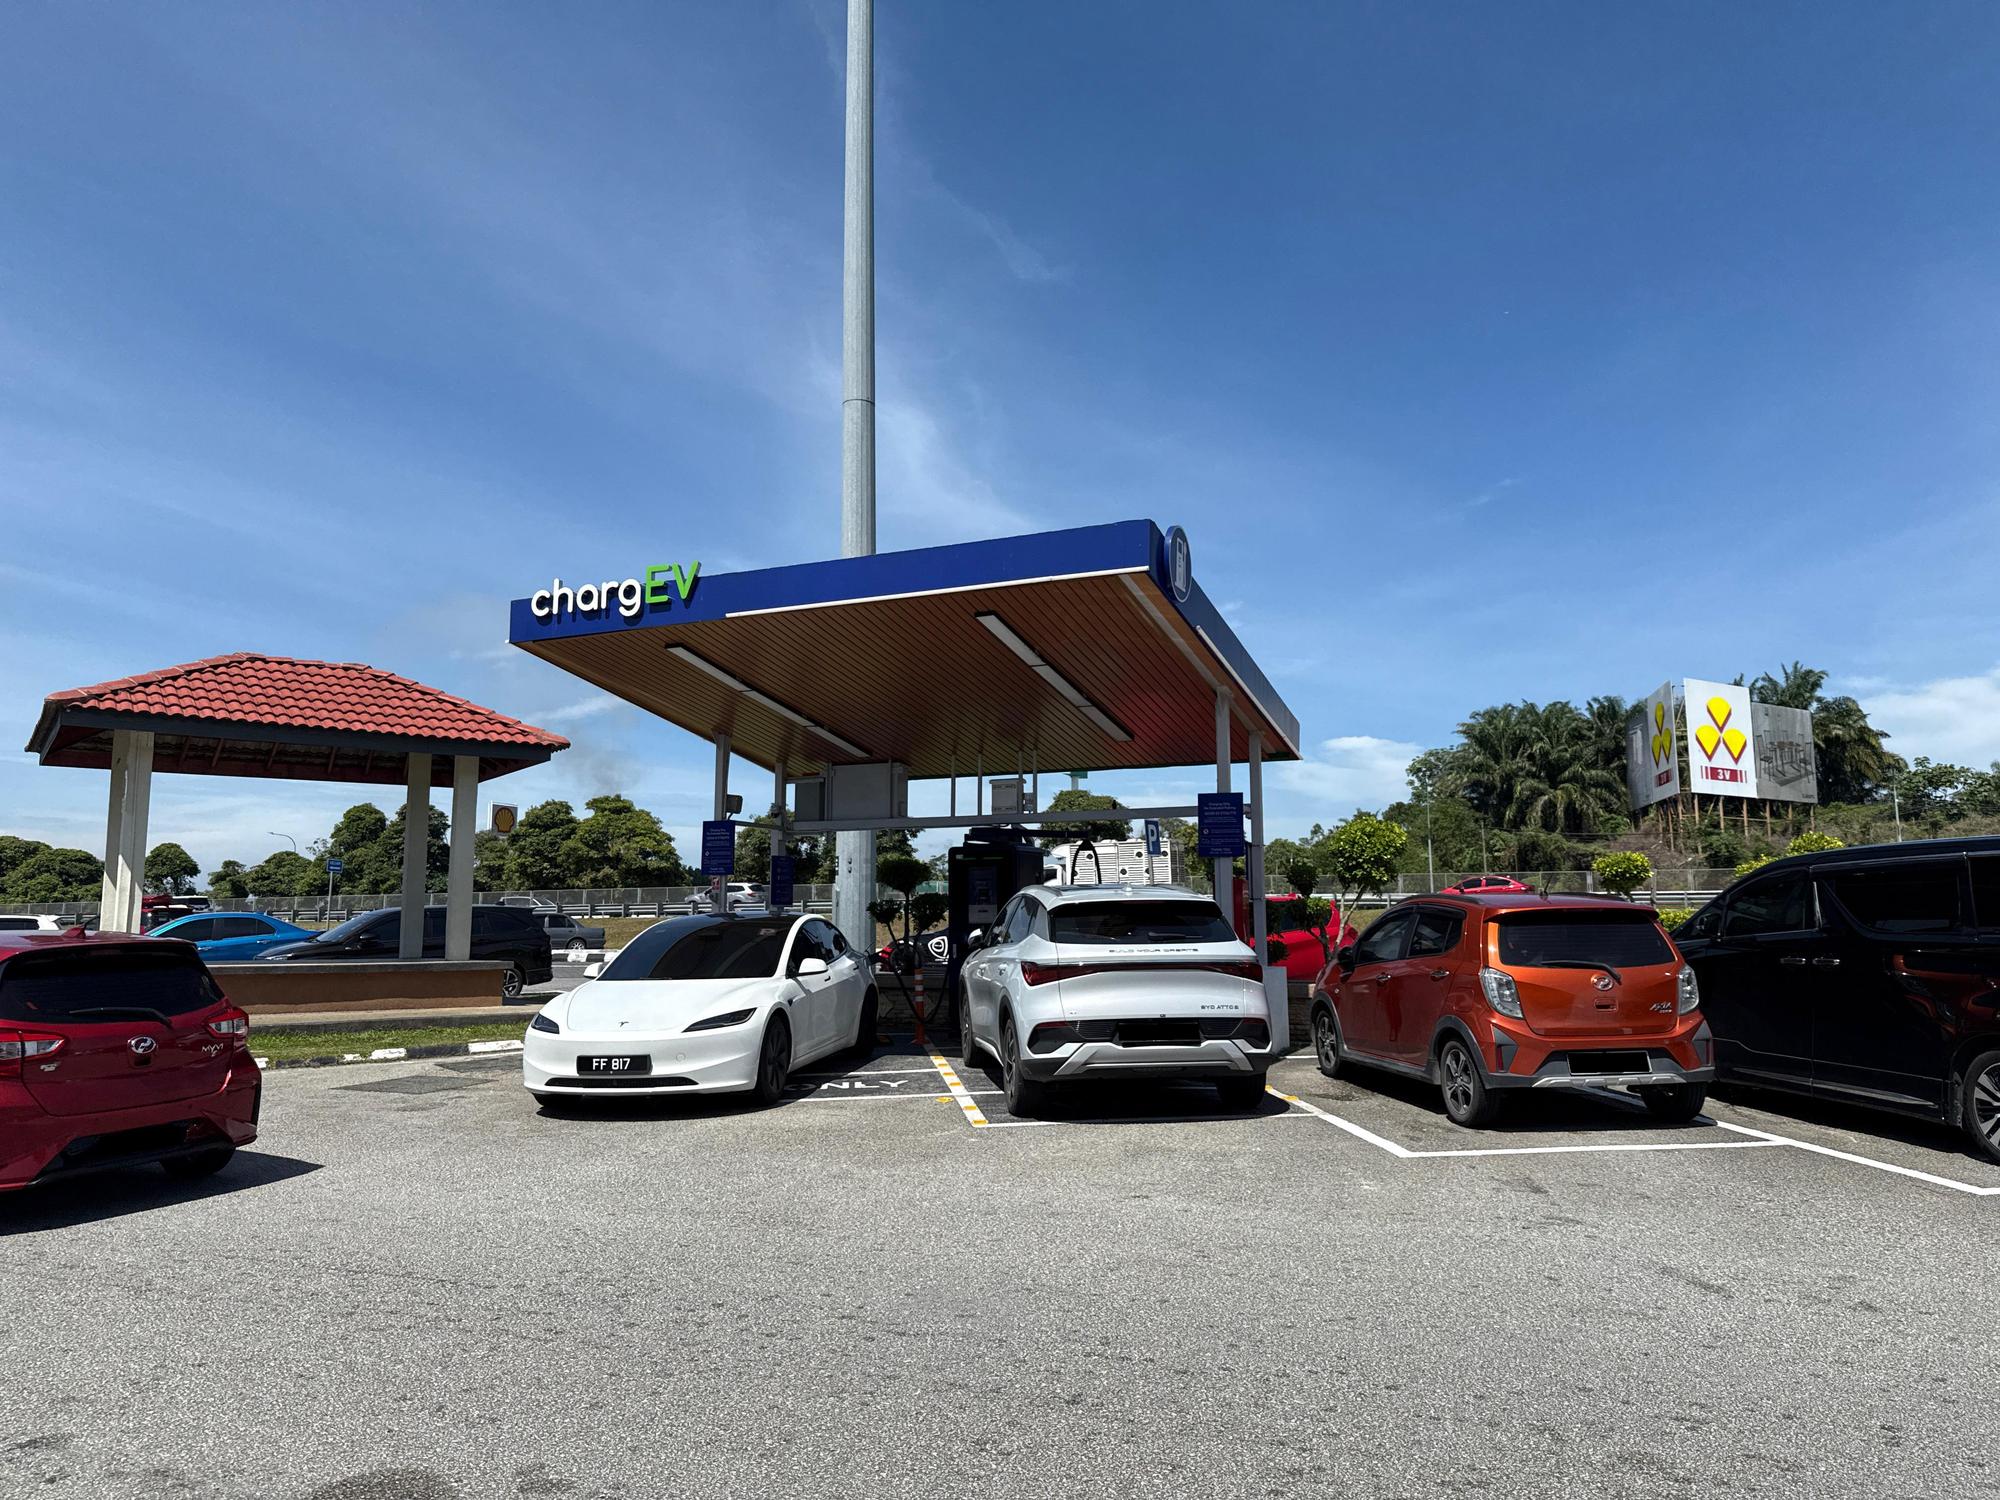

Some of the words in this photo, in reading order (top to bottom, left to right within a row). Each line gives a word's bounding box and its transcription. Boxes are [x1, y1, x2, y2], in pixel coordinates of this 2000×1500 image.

[531, 560, 701, 617] chargEV
[1716, 768, 1731, 781] 3V
[1147, 824, 1158, 852] P
[592, 1058, 608, 1071] FF
[611, 1058, 631, 1070] 817
